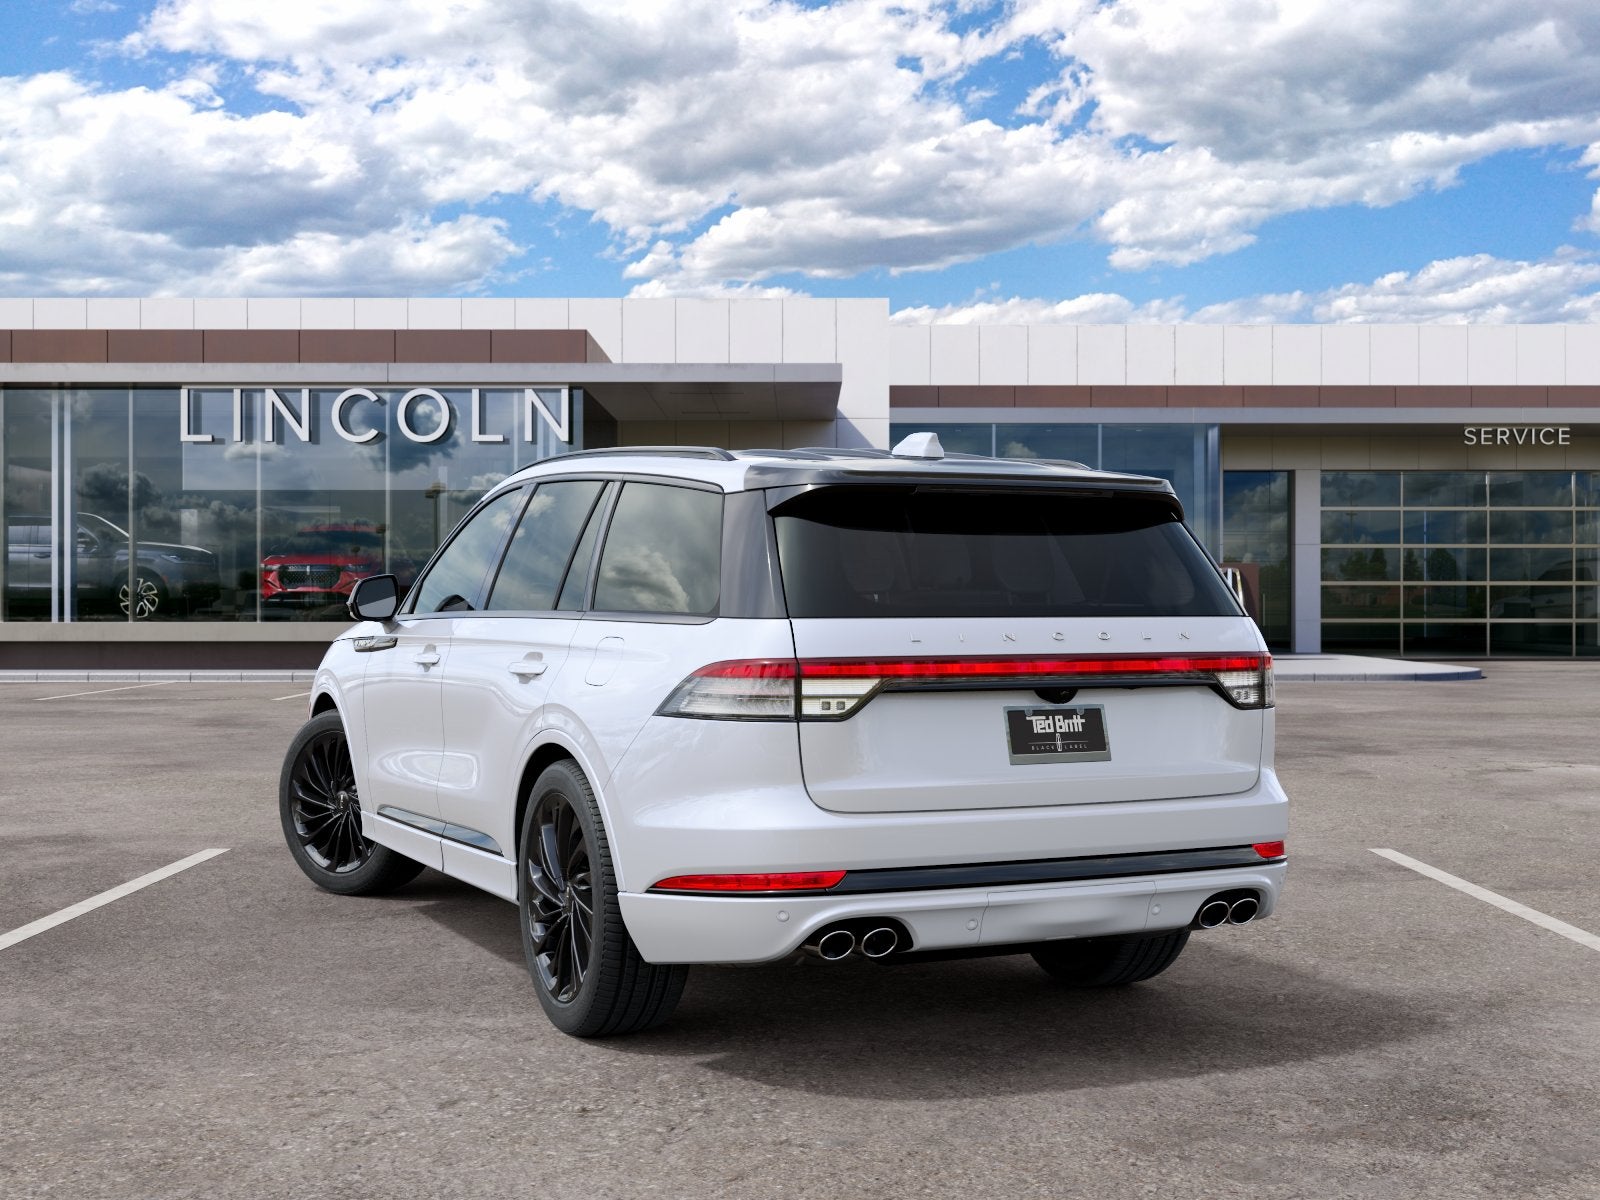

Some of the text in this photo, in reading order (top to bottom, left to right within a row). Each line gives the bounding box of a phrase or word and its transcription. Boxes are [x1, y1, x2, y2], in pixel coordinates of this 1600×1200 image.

[181, 388, 569, 442] LINCOLN
[1464, 428, 1570, 445] SERVICE
[909, 631, 1191, 642] LINCOLN
[1026, 715, 1055, 734] Ted
